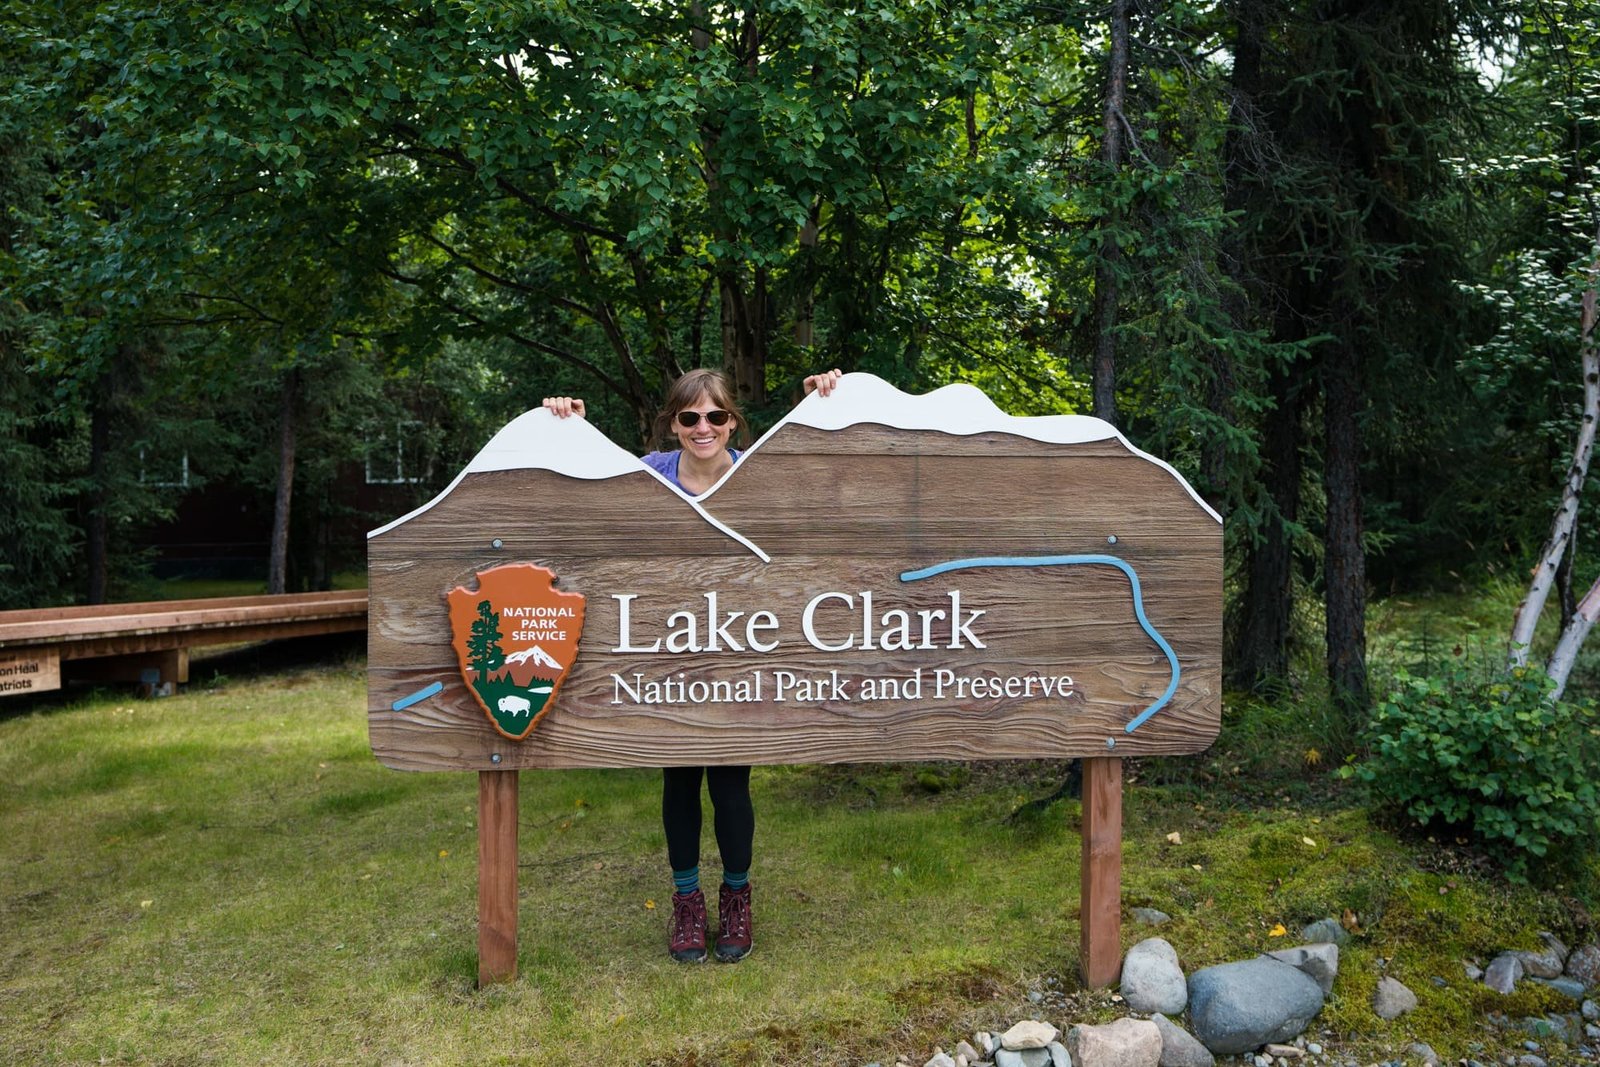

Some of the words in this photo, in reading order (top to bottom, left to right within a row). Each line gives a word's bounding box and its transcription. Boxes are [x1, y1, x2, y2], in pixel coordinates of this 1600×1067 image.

[503, 607, 576, 617] NATIONAL
[521, 619, 558, 629] PARK
[611, 591, 780, 653] Lake
[802, 590, 987, 652] Clark
[511, 630, 567, 641] SERVICE
[610, 671, 763, 705] National
[773, 670, 851, 702] Park
[860, 668, 923, 700] and
[933, 669, 1074, 699] Preserve
